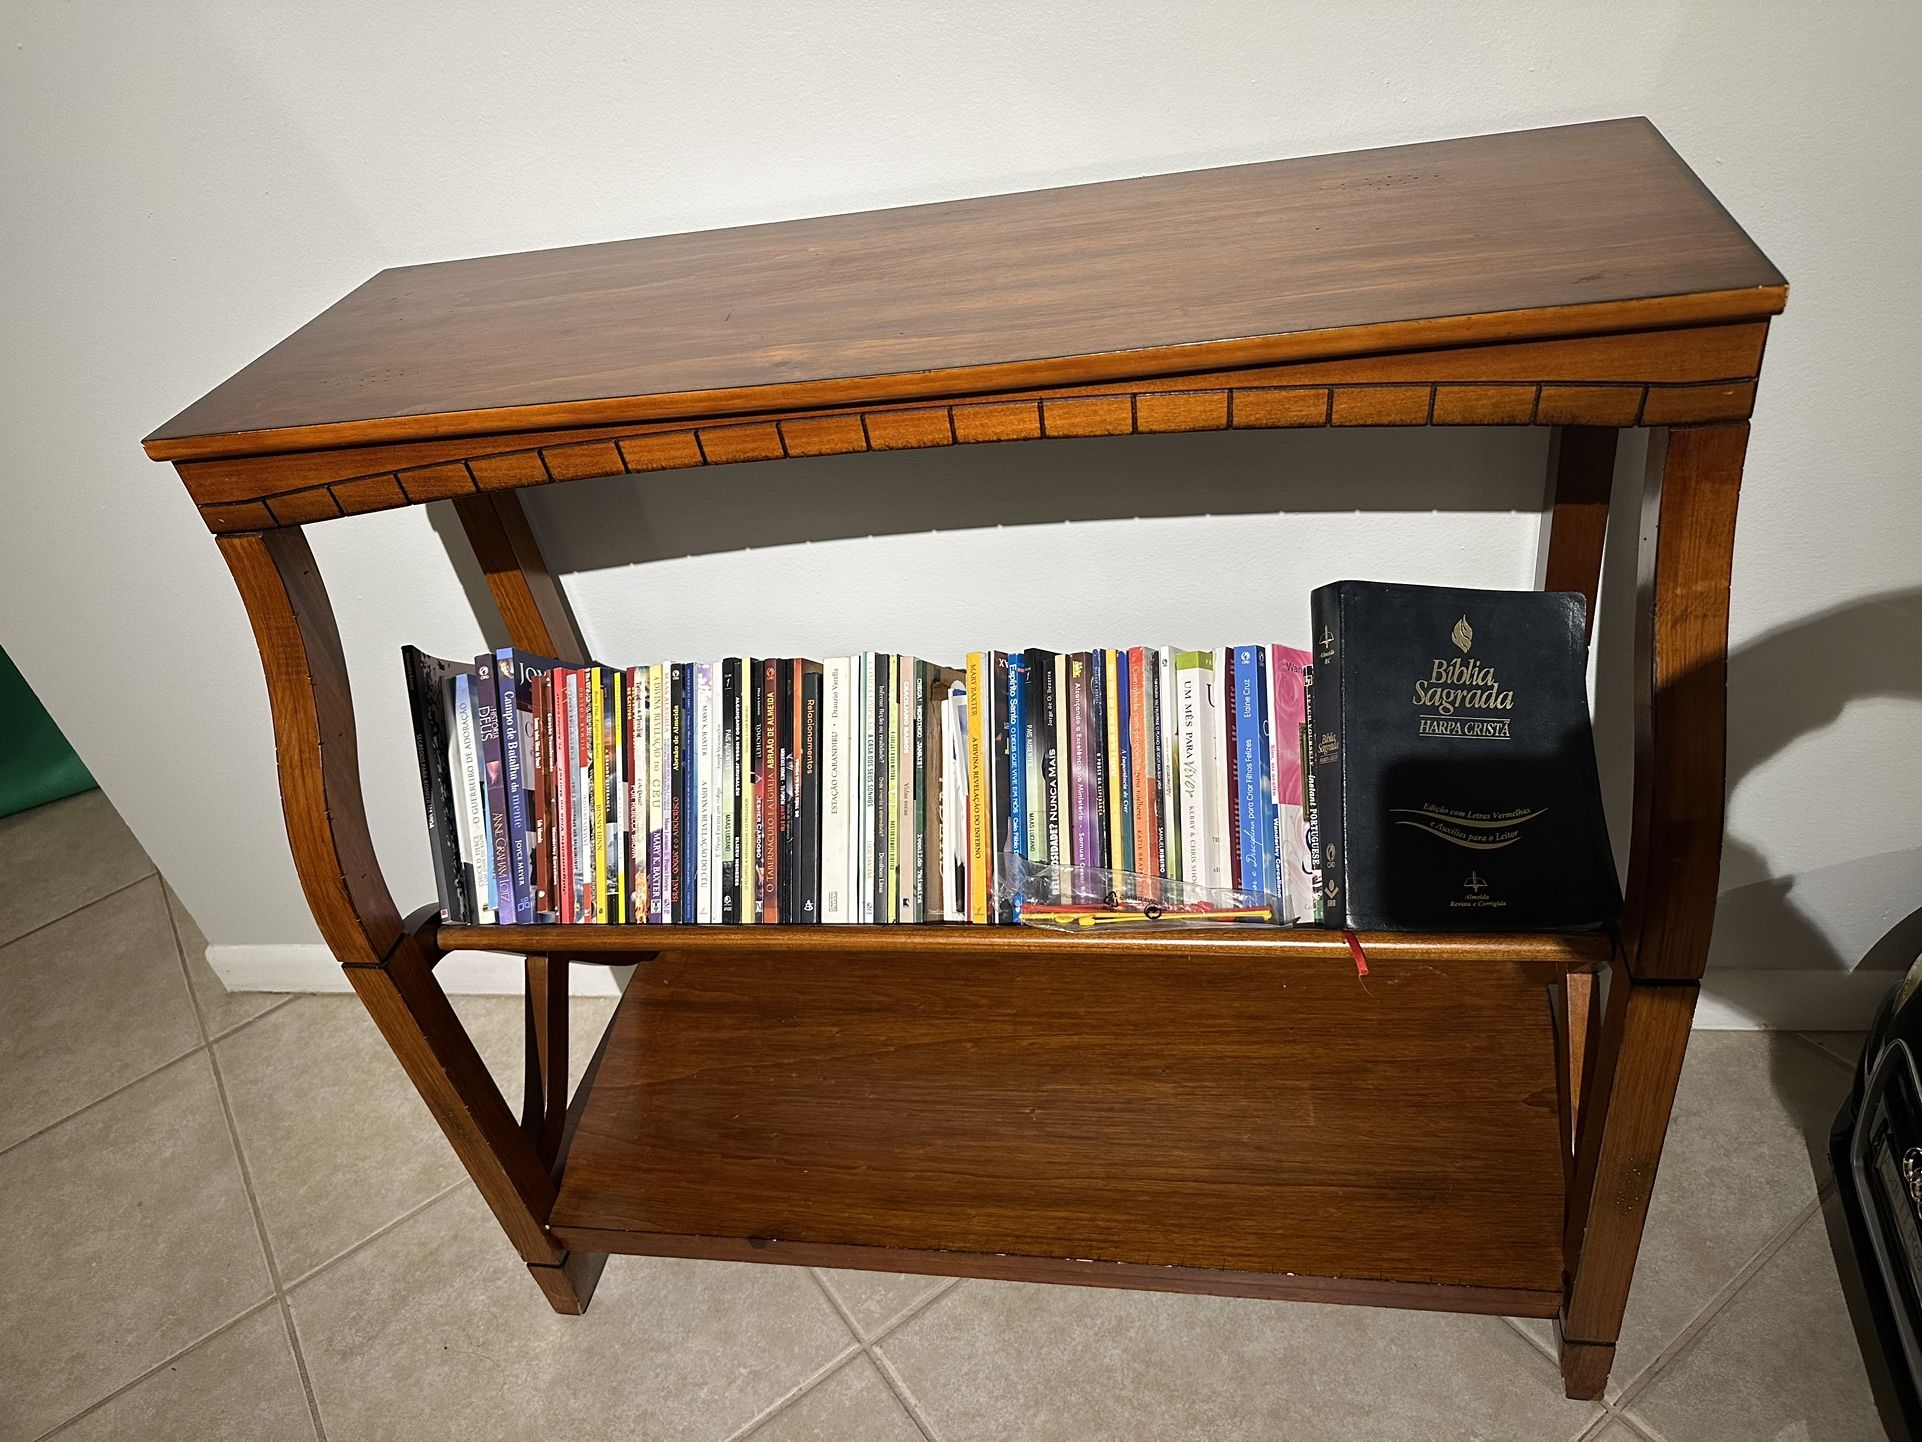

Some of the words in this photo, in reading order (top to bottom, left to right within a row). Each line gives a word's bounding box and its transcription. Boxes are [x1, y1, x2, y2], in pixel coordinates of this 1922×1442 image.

[831, 668, 839, 690] Varella
[1008, 664, 1018, 696] Espírito
[1429, 657, 1495, 686] Bíblia
[653, 682, 661, 709] DIVINA
[970, 687, 978, 716] BAXTER
[1074, 682, 1082, 724] Alcançando
[1184, 681, 1192, 699] UM
[1412, 679, 1514, 715] Sagrada
[503, 691, 518, 726] Campo
[701, 705, 709, 723] MARY
[766, 692, 774, 726] ALMEIDA
[831, 691, 839, 718] Drauzio
[877, 708, 885, 726] ficção
[1009, 699, 1018, 725] Santo
[1185, 703, 1195, 726] MÊS
[459, 702, 471, 748] ADORAÇÃO
[479, 706, 493, 742] DEUS
[507, 728, 517, 740] de
[652, 713, 663, 758] REVELAÇÃO
[767, 726, 774, 737] DE
[806, 699, 815, 775] Relacionamentos
[1419, 719, 1462, 735] HARPA
[1464, 719, 1511, 737] CRISTÃ
[465, 752, 472, 762] DE
[701, 731, 709, 756] BAXTER
[765, 739, 774, 769] ABRAÃO
[878, 735, 886, 763] realidade?
[972, 744, 980, 769] DIVINA
[1026, 739, 1034, 767] AUSENTES
[1076, 734, 1084, 770] Excelência
[1185, 732, 1193, 758] PARA
[508, 741, 521, 780] Batalha
[653, 761, 660, 772] DO
[1048, 749, 1057, 776] MAIS
[1121, 755, 1129, 790] Importância
[1245, 763, 1253, 782] Filhos
[466, 764, 479, 815] GUERREIRO
[511, 782, 519, 793] da
[734, 762, 742, 797] JERUSALÉM
[766, 773, 775, 802] IGREJA
[972, 771, 982, 813] REVELAÇÃO
[1184, 759, 1197, 798] Viver
[1308, 775, 1317, 807] instant
[652, 779, 663, 808] CÉU
[831, 779, 840, 815] ESTAÇÃO
[1012, 798, 1020, 813] NÓS
[1049, 780, 1058, 821] NUNCA
[1078, 784, 1086, 820] Ministério
[493, 813, 505, 837] ANNE
[512, 794, 523, 829] mente
[595, 804, 603, 830] BENNY
[1423, 802, 1449, 815] Edição
[1449, 809, 1466, 818] com
[1467, 810, 1491, 820] Letras
[1492, 807, 1531, 819] Vermelhas
[652, 832, 661, 854] MARY
[700, 814, 709, 858] REVELAÇÃO
[974, 828, 982, 859] INFERNO
[1273, 818, 1281, 857] Wanderley
[1310, 808, 1320, 865] PORTUGUESE
[1436, 822, 1467, 838] Auxílios
[1467, 833, 1486, 842] para
[1495, 830, 1519, 841] Leitor
[495, 837, 507, 877] GRAHAM
[515, 839, 523, 861] JOYCE
[652, 855, 661, 865] K.
[517, 862, 525, 886] MEYER
[701, 859, 708, 871] DO
[499, 879, 510, 903] LOTZ
[652, 866, 661, 898] BAXTER
[701, 872, 710, 888] CÉU
[766, 884, 774, 893] O
